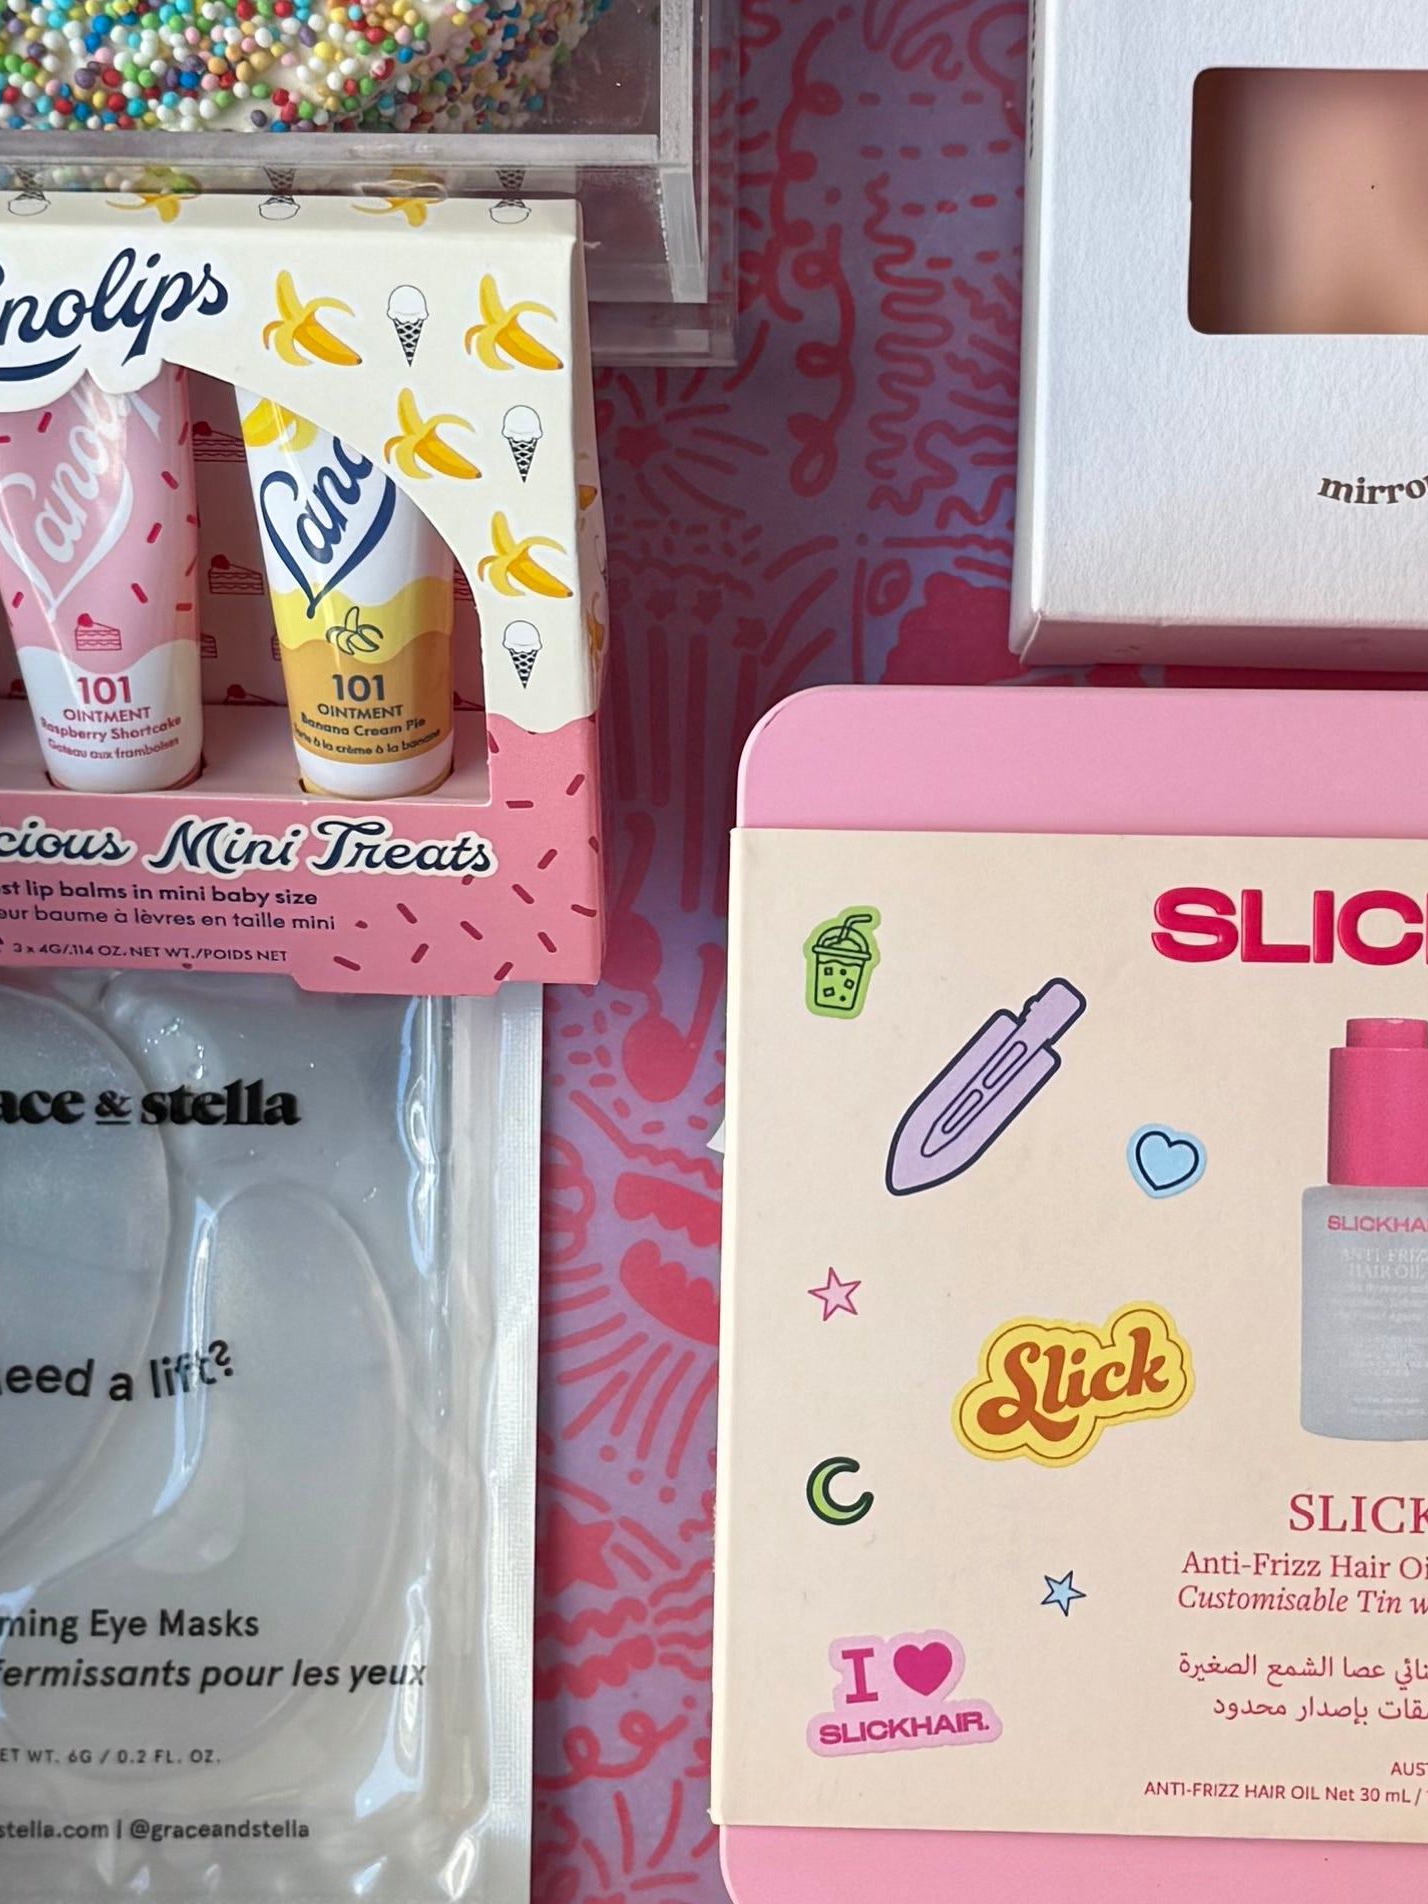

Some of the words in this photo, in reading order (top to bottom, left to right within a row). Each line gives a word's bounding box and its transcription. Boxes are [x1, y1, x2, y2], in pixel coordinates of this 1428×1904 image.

[77, 676, 133, 705] 101
[332, 674, 386, 701] 101
[63, 707, 151, 723] OINTMENT
[317, 704, 404, 720] OINTMENT
[111, 715, 182, 740] Shortcake
[354, 724, 403, 738] Cream
[406, 717, 427, 732] Pie
[148, 819, 304, 875] Mini
[311, 820, 495, 874] Treats
[25, 880, 53, 900] lip
[58, 881, 127, 900] balms
[133, 883, 153, 900] in
[159, 884, 206, 903] mini
[212, 886, 271, 908] baby
[275, 889, 318, 906] size
[34, 905, 109, 923] baume
[115, 907, 128, 925] à
[134, 908, 197, 927] lèvres
[201, 914, 228, 928] en
[232, 911, 286, 929] taille
[292, 914, 336, 931] mini
[12, 942, 23, 954] 3
[26, 945, 35, 954] x
[129, 946, 160, 958] NET
[257, 949, 288, 963] NET
[95, 1089, 131, 1125] &
[140, 1078, 302, 1128] stella
[108, 1369, 134, 1402] a
[149, 1338, 237, 1399] lift?
[977, 1327, 1170, 1442] Slick
[1182, 1550, 1322, 1579] Anti-Frizz
[1330, 1553, 1392, 1581] Hair
[1177, 1584, 1349, 1613] Customisable
[1358, 1587, 1403, 1614] Tin
[89, 1609, 148, 1643] Eye
[159, 1608, 261, 1637] Masks
[199, 1664, 284, 1694] pour
[291, 1658, 341, 1687] les
[348, 1661, 427, 1695] yeux
[841, 1647, 879, 1704] I
[1178, 1652, 1258, 1682] الصغيرة
[1266, 1655, 1334, 1687] الشمع
[1343, 1657, 1386, 1679] عصا
[1213, 1697, 1288, 1721] محدود
[1294, 1696, 1369, 1726] بإصدار
[819, 1711, 990, 1745] SLICKHAIR.
[26, 1747, 62, 1764] WT.
[68, 1747, 94, 1764] 6G
[117, 1748, 149, 1764] 0.2
[154, 1748, 186, 1765] FL.
[190, 1748, 223, 1765] OZ.
[1144, 1781, 1240, 1798] ANTI-FRIZZ
[1245, 1784, 1286, 1800] HAIR
[1290, 1786, 1321, 1801] OIL
[1325, 1787, 1355, 1802] Net
[1360, 1788, 1381, 1802] 30
[1385, 1789, 1412, 1804] mL
[129, 1818, 311, 1843] @graceandstella
